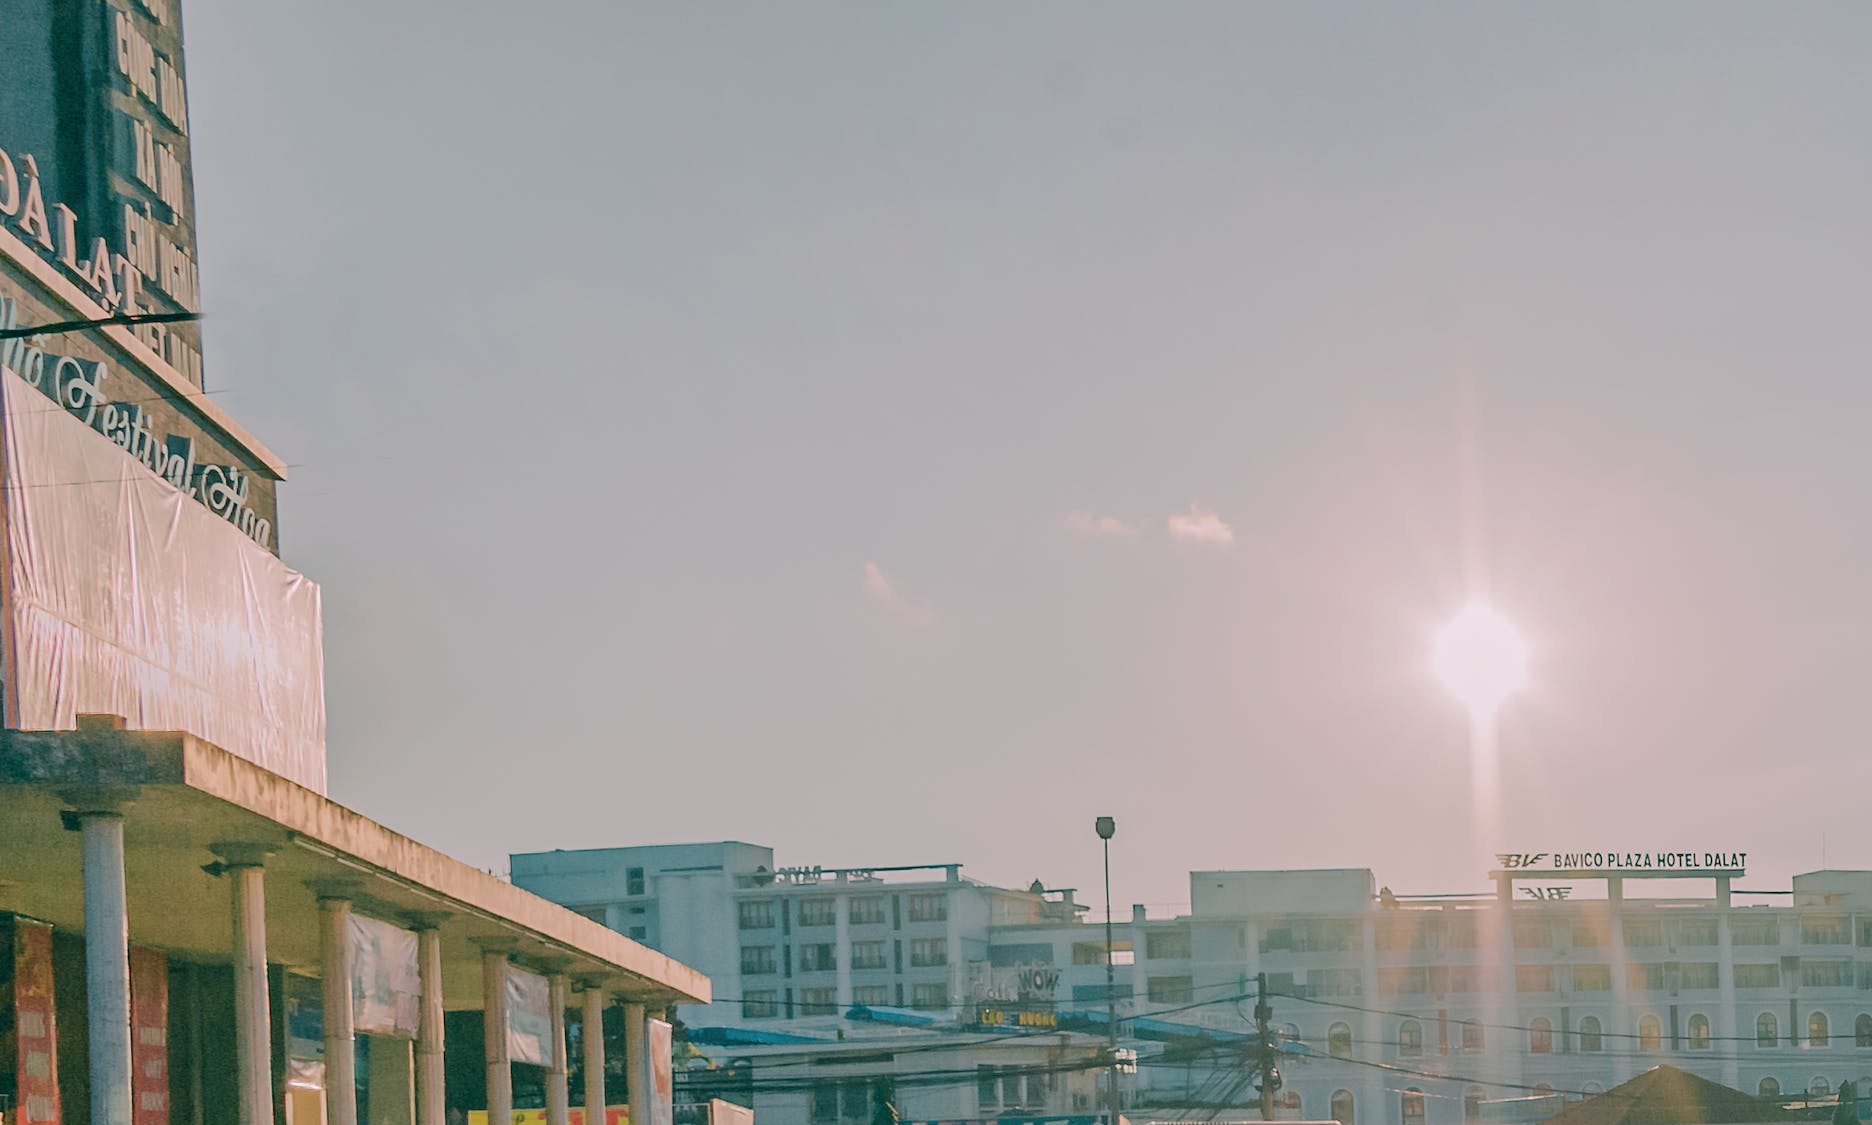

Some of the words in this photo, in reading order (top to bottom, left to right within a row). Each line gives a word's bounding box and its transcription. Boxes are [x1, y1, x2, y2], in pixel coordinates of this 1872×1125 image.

[116, 10, 157, 104] CỘNG
[55, 356, 196, 499] Festival
[1554, 853, 1603, 868] BAVICO
[1607, 853, 1651, 868] PLAZA
[1657, 853, 1700, 868] HOTEL
[1704, 852, 1748, 868] DALAT
